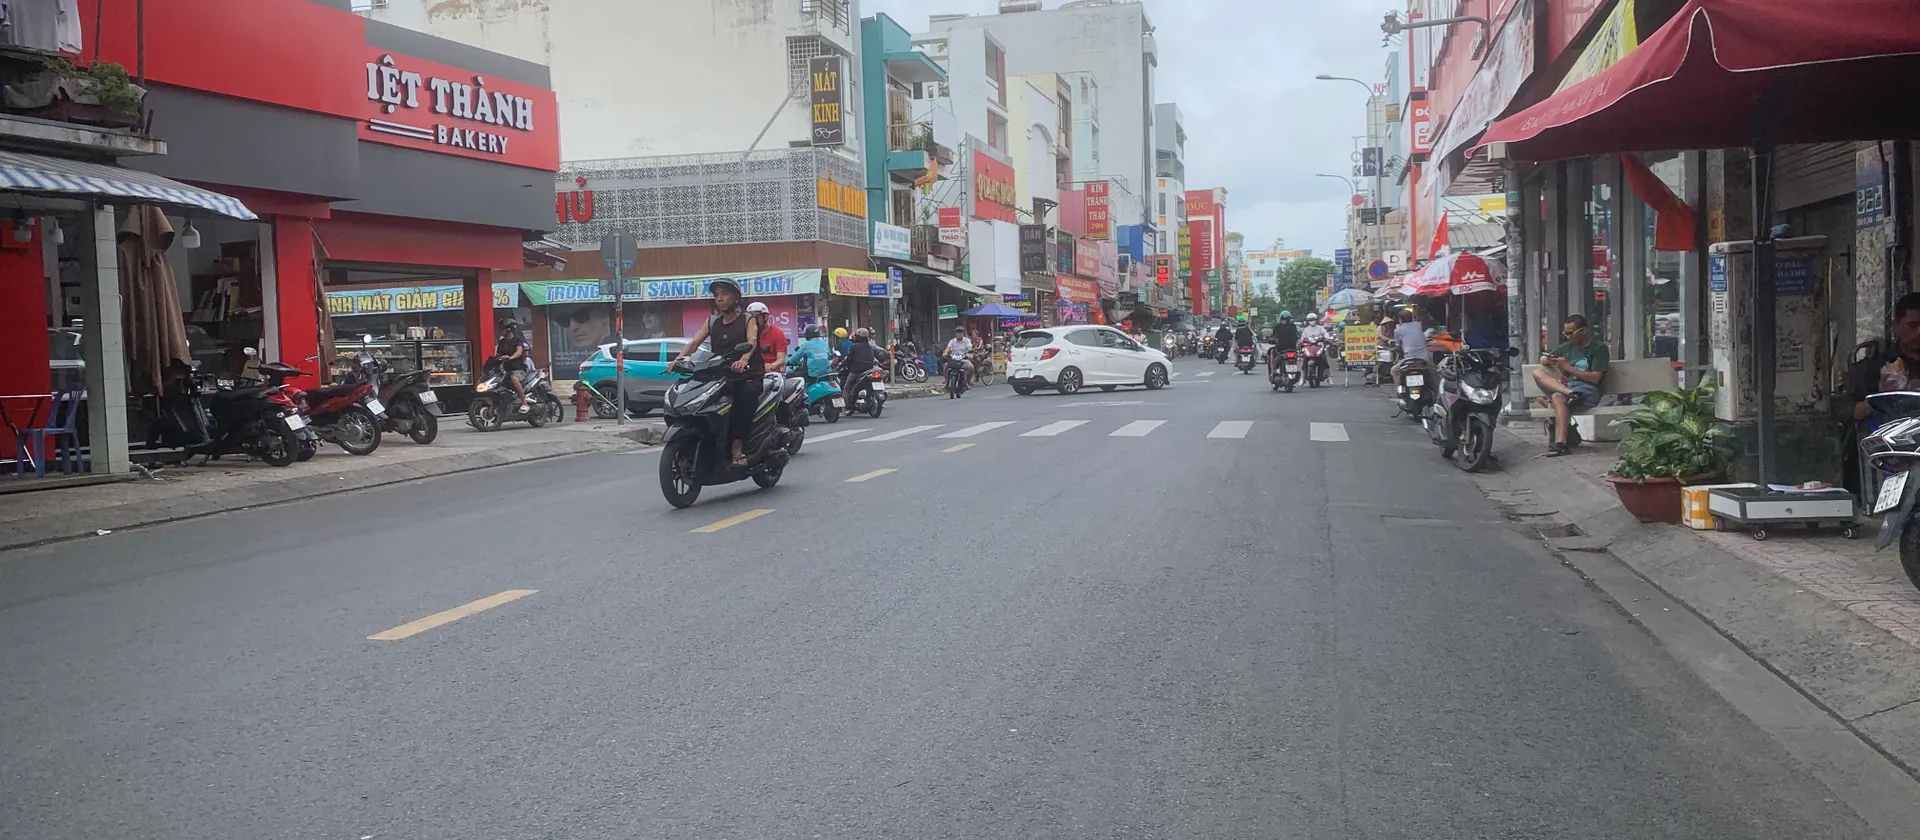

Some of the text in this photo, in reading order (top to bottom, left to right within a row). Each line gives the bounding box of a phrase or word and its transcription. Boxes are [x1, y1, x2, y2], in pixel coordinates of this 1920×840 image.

[814, 61, 837, 92] MẮT
[431, 76, 534, 131] THÀNH
[814, 98, 840, 123] KÍNH
[438, 124, 508, 154] BAKERY
[1090, 184, 1104, 193] KIM
[395, 288, 438, 310] GIẢM
[648, 280, 697, 298] SANG
[754, 276, 793, 294] 6IN1
